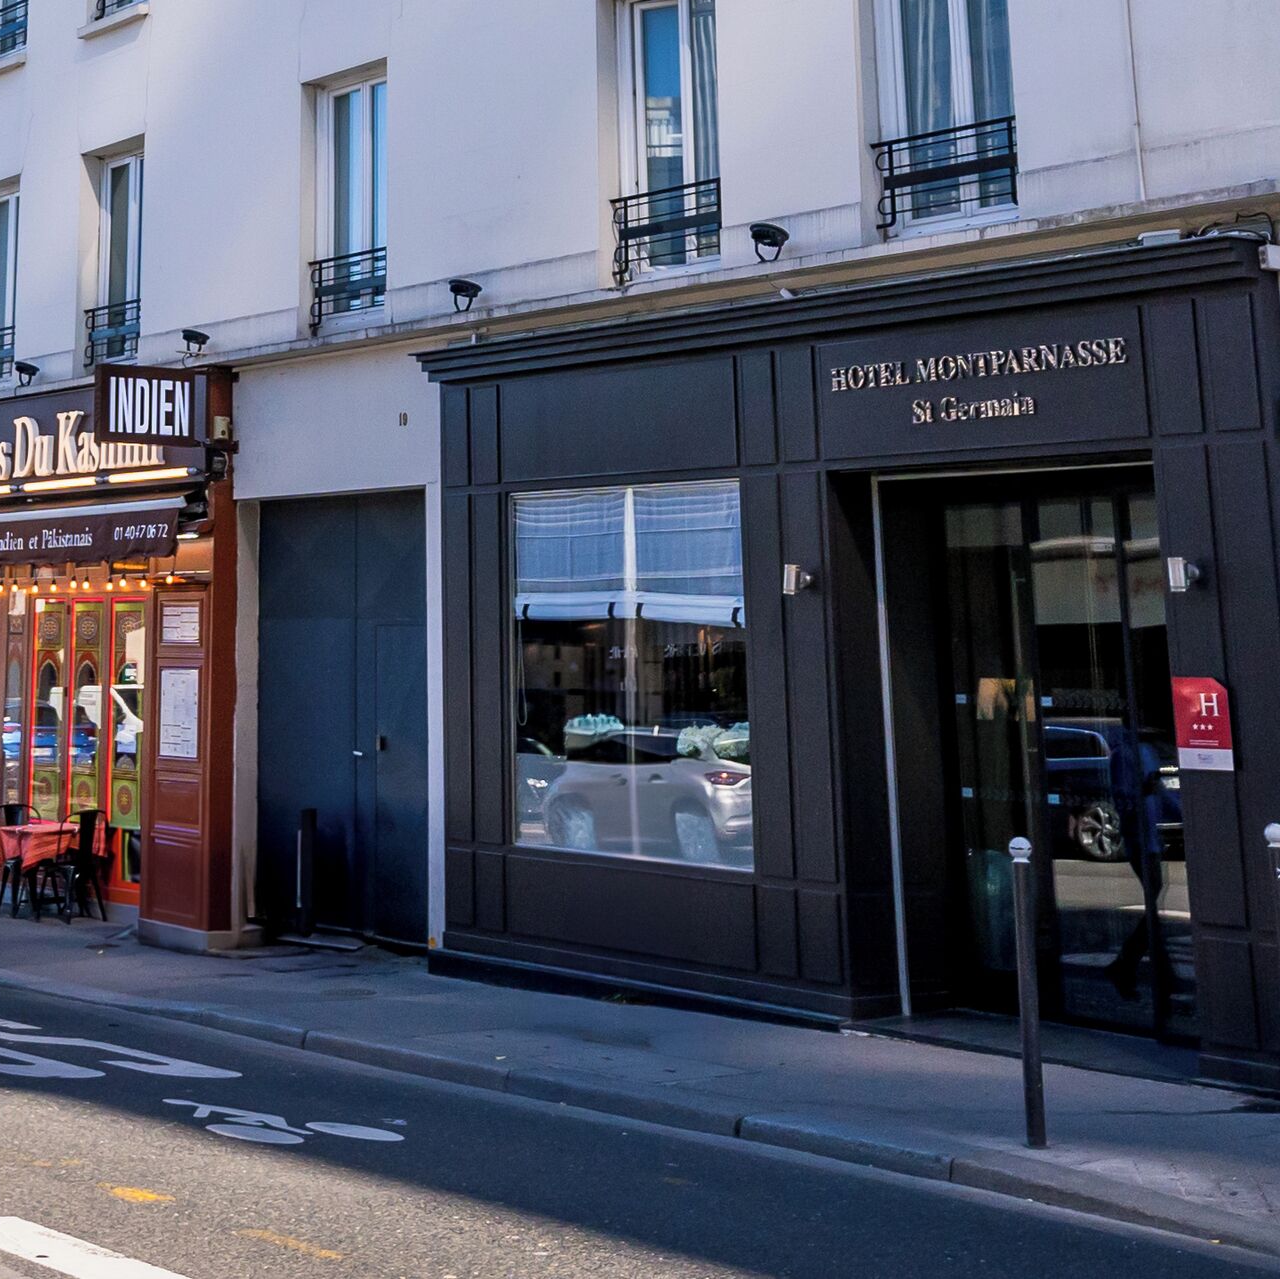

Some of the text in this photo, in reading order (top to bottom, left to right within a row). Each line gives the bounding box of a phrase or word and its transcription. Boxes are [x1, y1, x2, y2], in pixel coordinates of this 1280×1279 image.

[831, 337, 1128, 392] HOTEL MONTPARNASSE
[109, 376, 191, 437] INDIEN
[912, 392, 1036, 424] St Germain
[13, 415, 55, 479] Du
[29, 535, 38, 550] et
[1199, 692, 1220, 717] H
